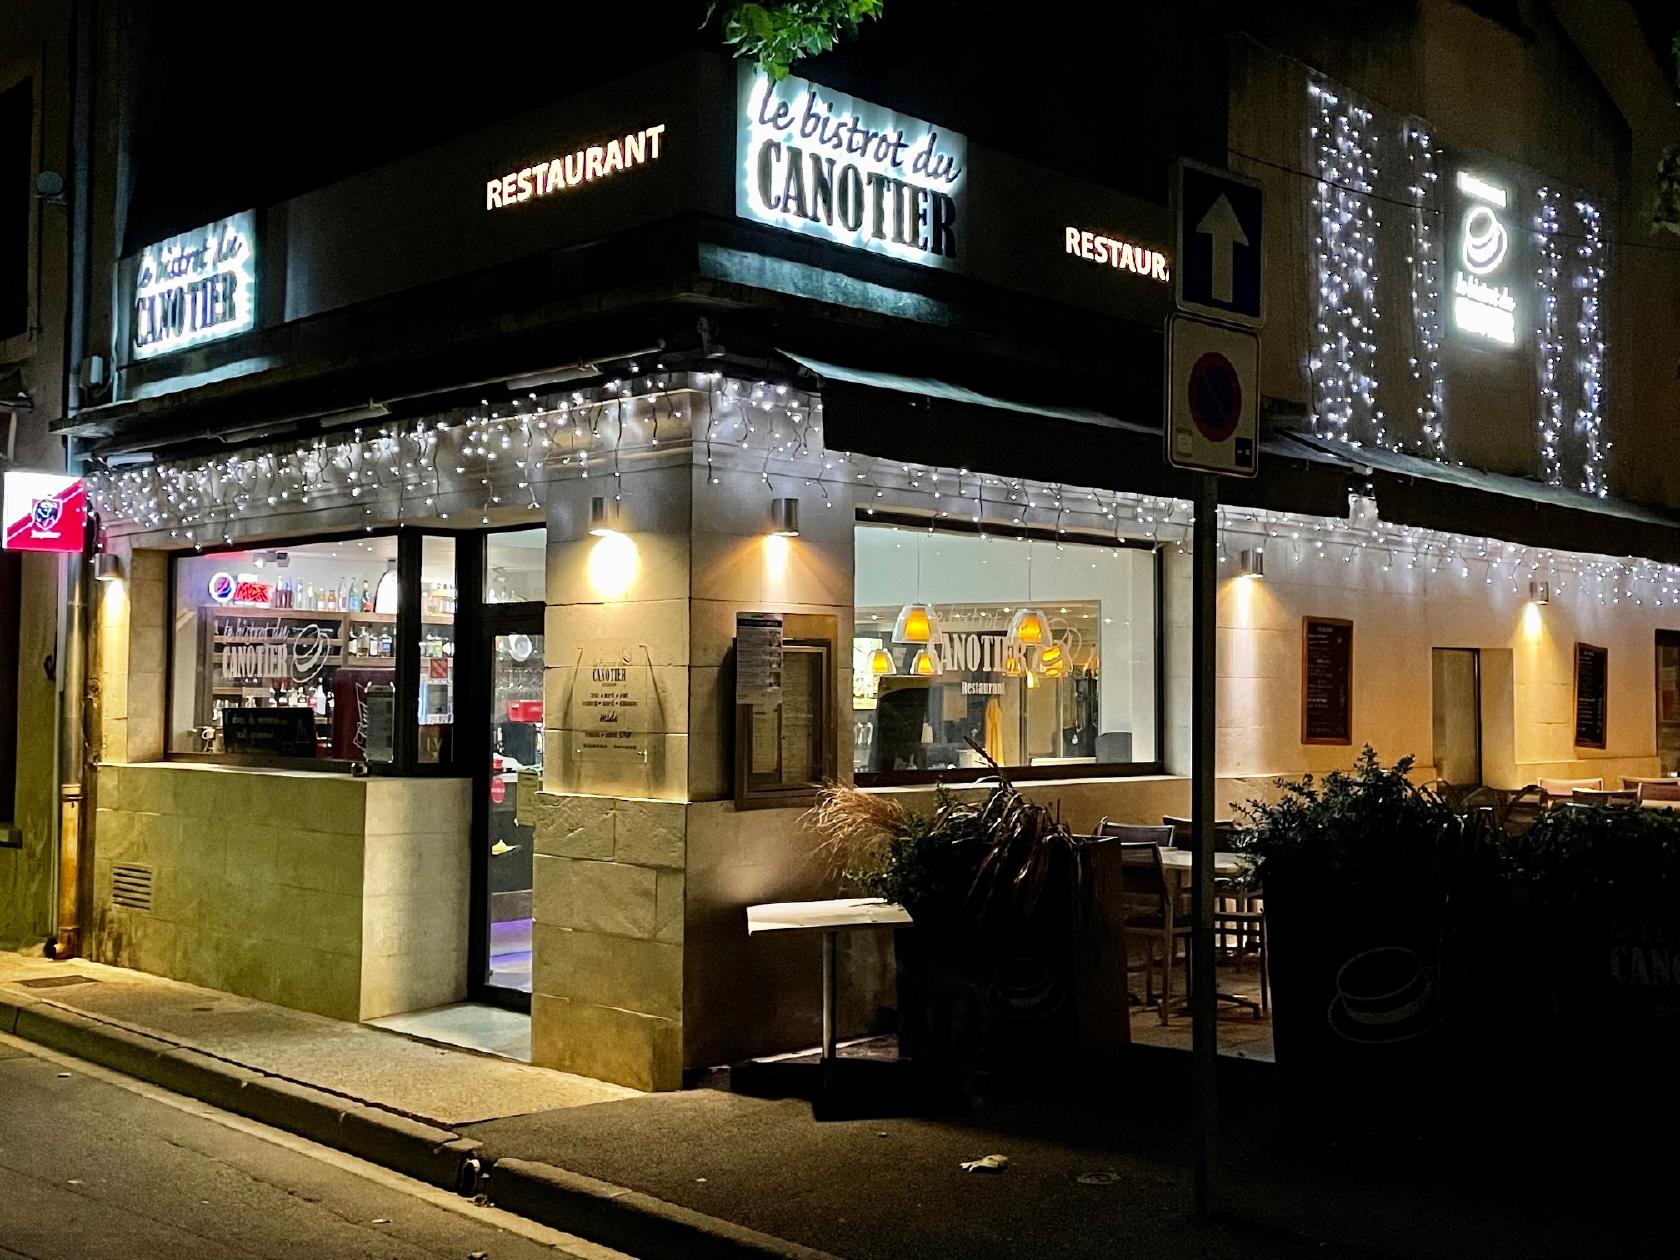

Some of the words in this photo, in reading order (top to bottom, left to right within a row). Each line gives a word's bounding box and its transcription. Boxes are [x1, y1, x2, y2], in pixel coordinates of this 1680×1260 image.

[759, 78, 796, 130] le
[799, 91, 909, 168] bistrot
[912, 132, 961, 183] du
[486, 124, 665, 210] RESTAURANT
[757, 139, 956, 258] CANOTIER
[1065, 226, 1170, 284] RESTAUR
[136, 270, 238, 348] CANOTIER
[222, 643, 289, 679] CANOTIER
[592, 668, 626, 682] CANOTIER
[961, 681, 1005, 695] Restaurant
